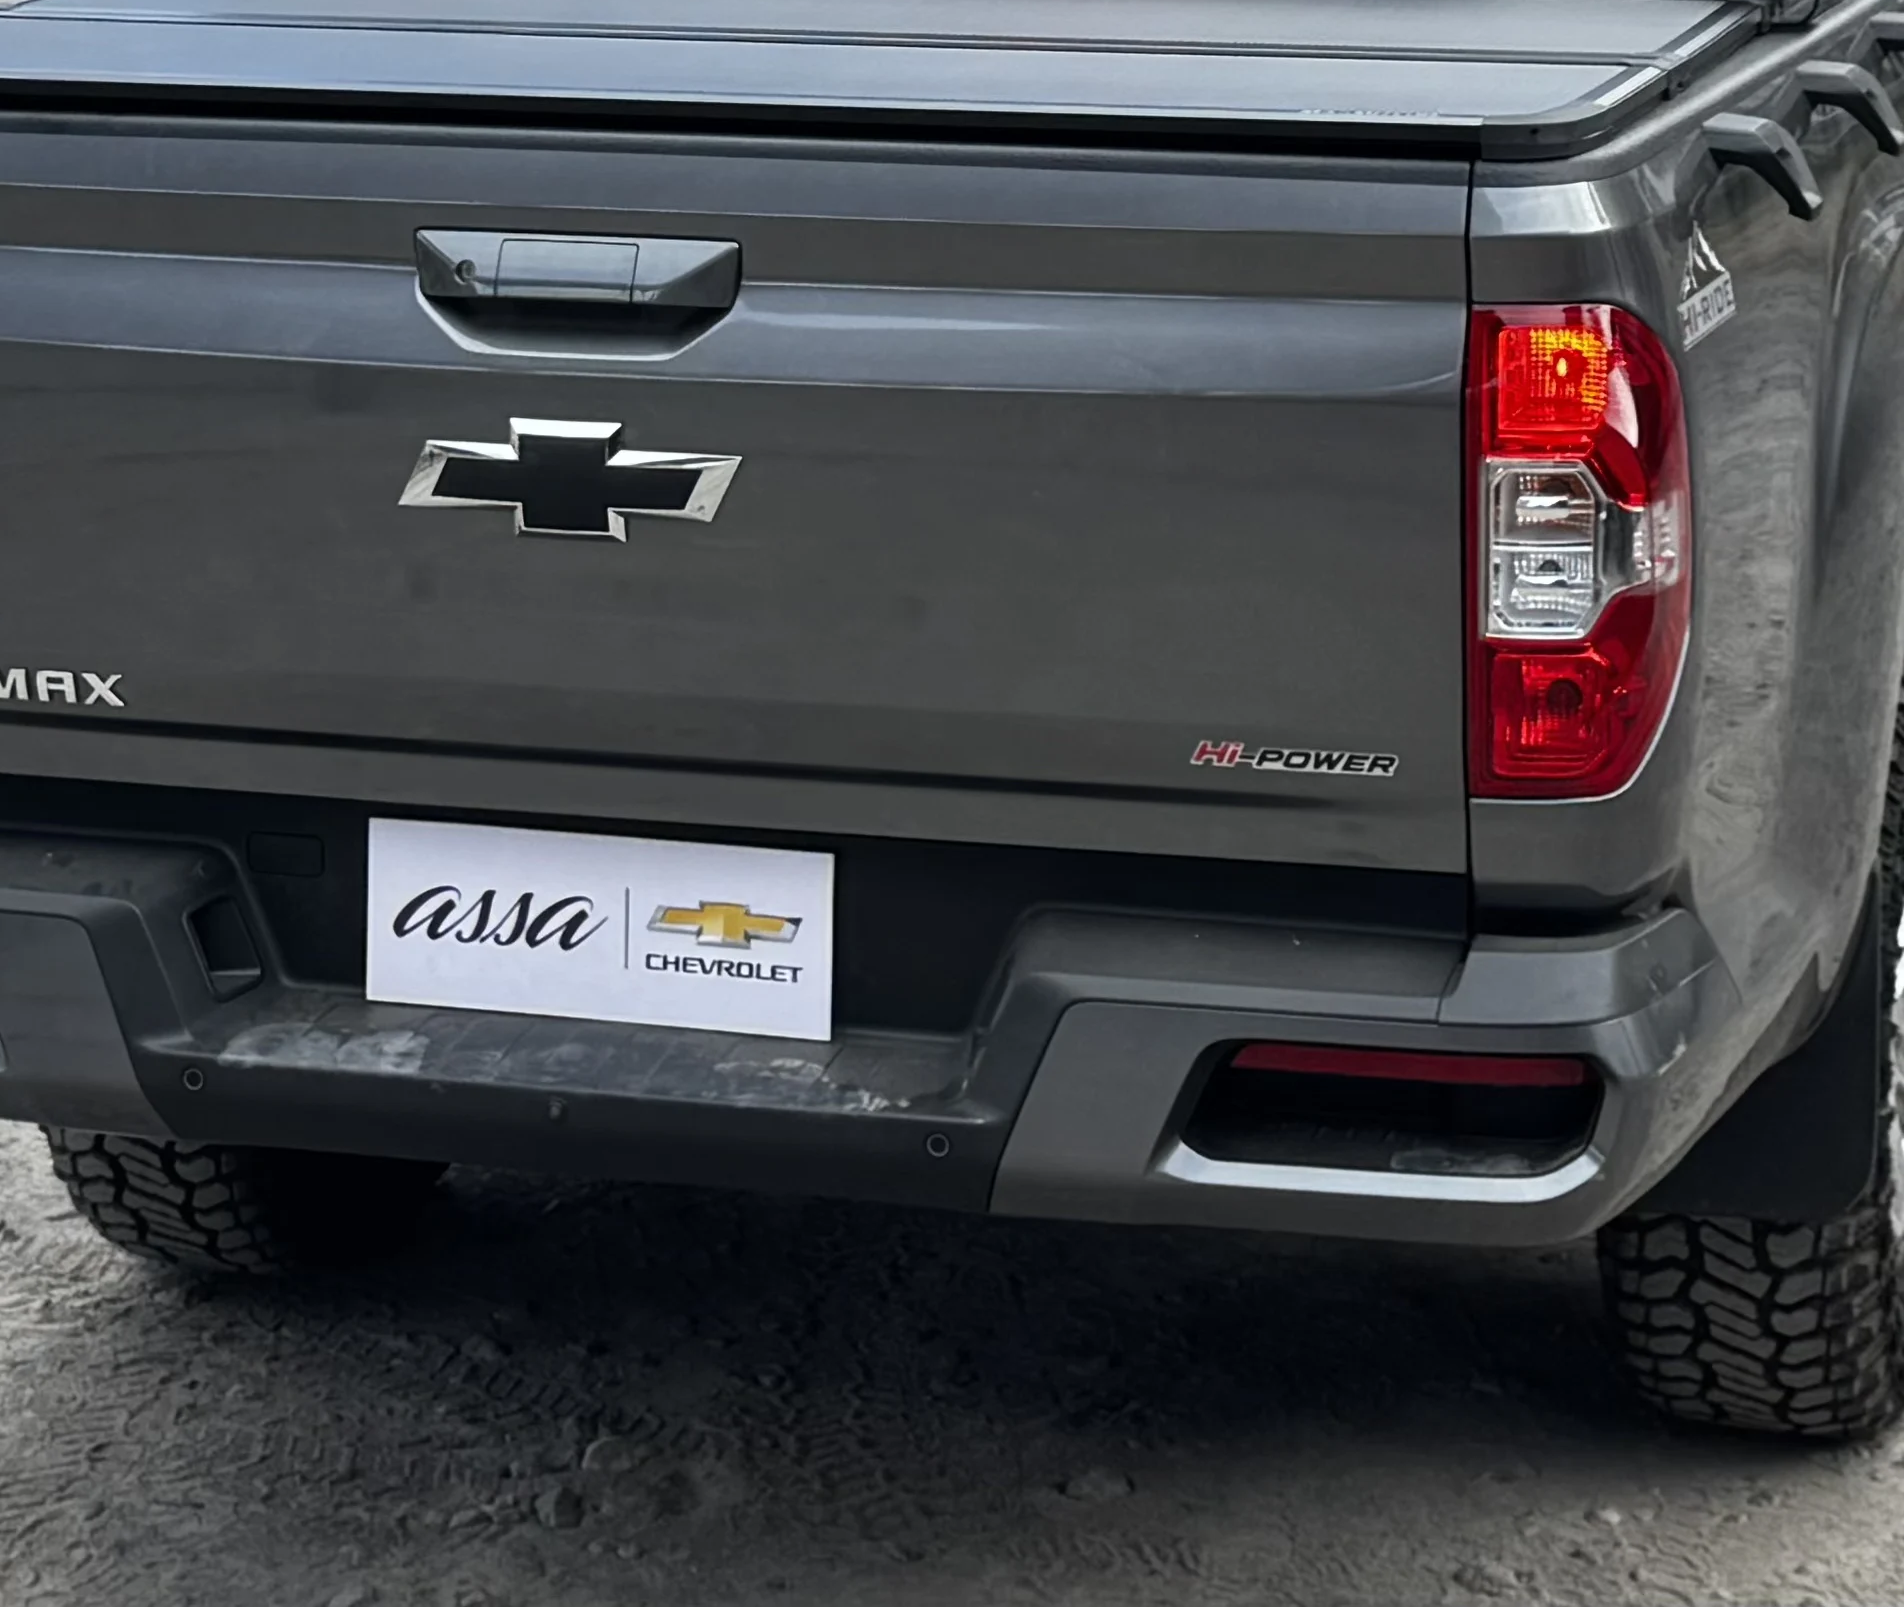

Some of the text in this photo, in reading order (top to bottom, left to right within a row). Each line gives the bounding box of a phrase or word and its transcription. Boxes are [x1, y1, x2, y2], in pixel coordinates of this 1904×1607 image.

[1191, 741, 1398, 776] Hi-POWER
[392, 885, 608, 951] assa
[645, 953, 803, 983] CHEVROLET
